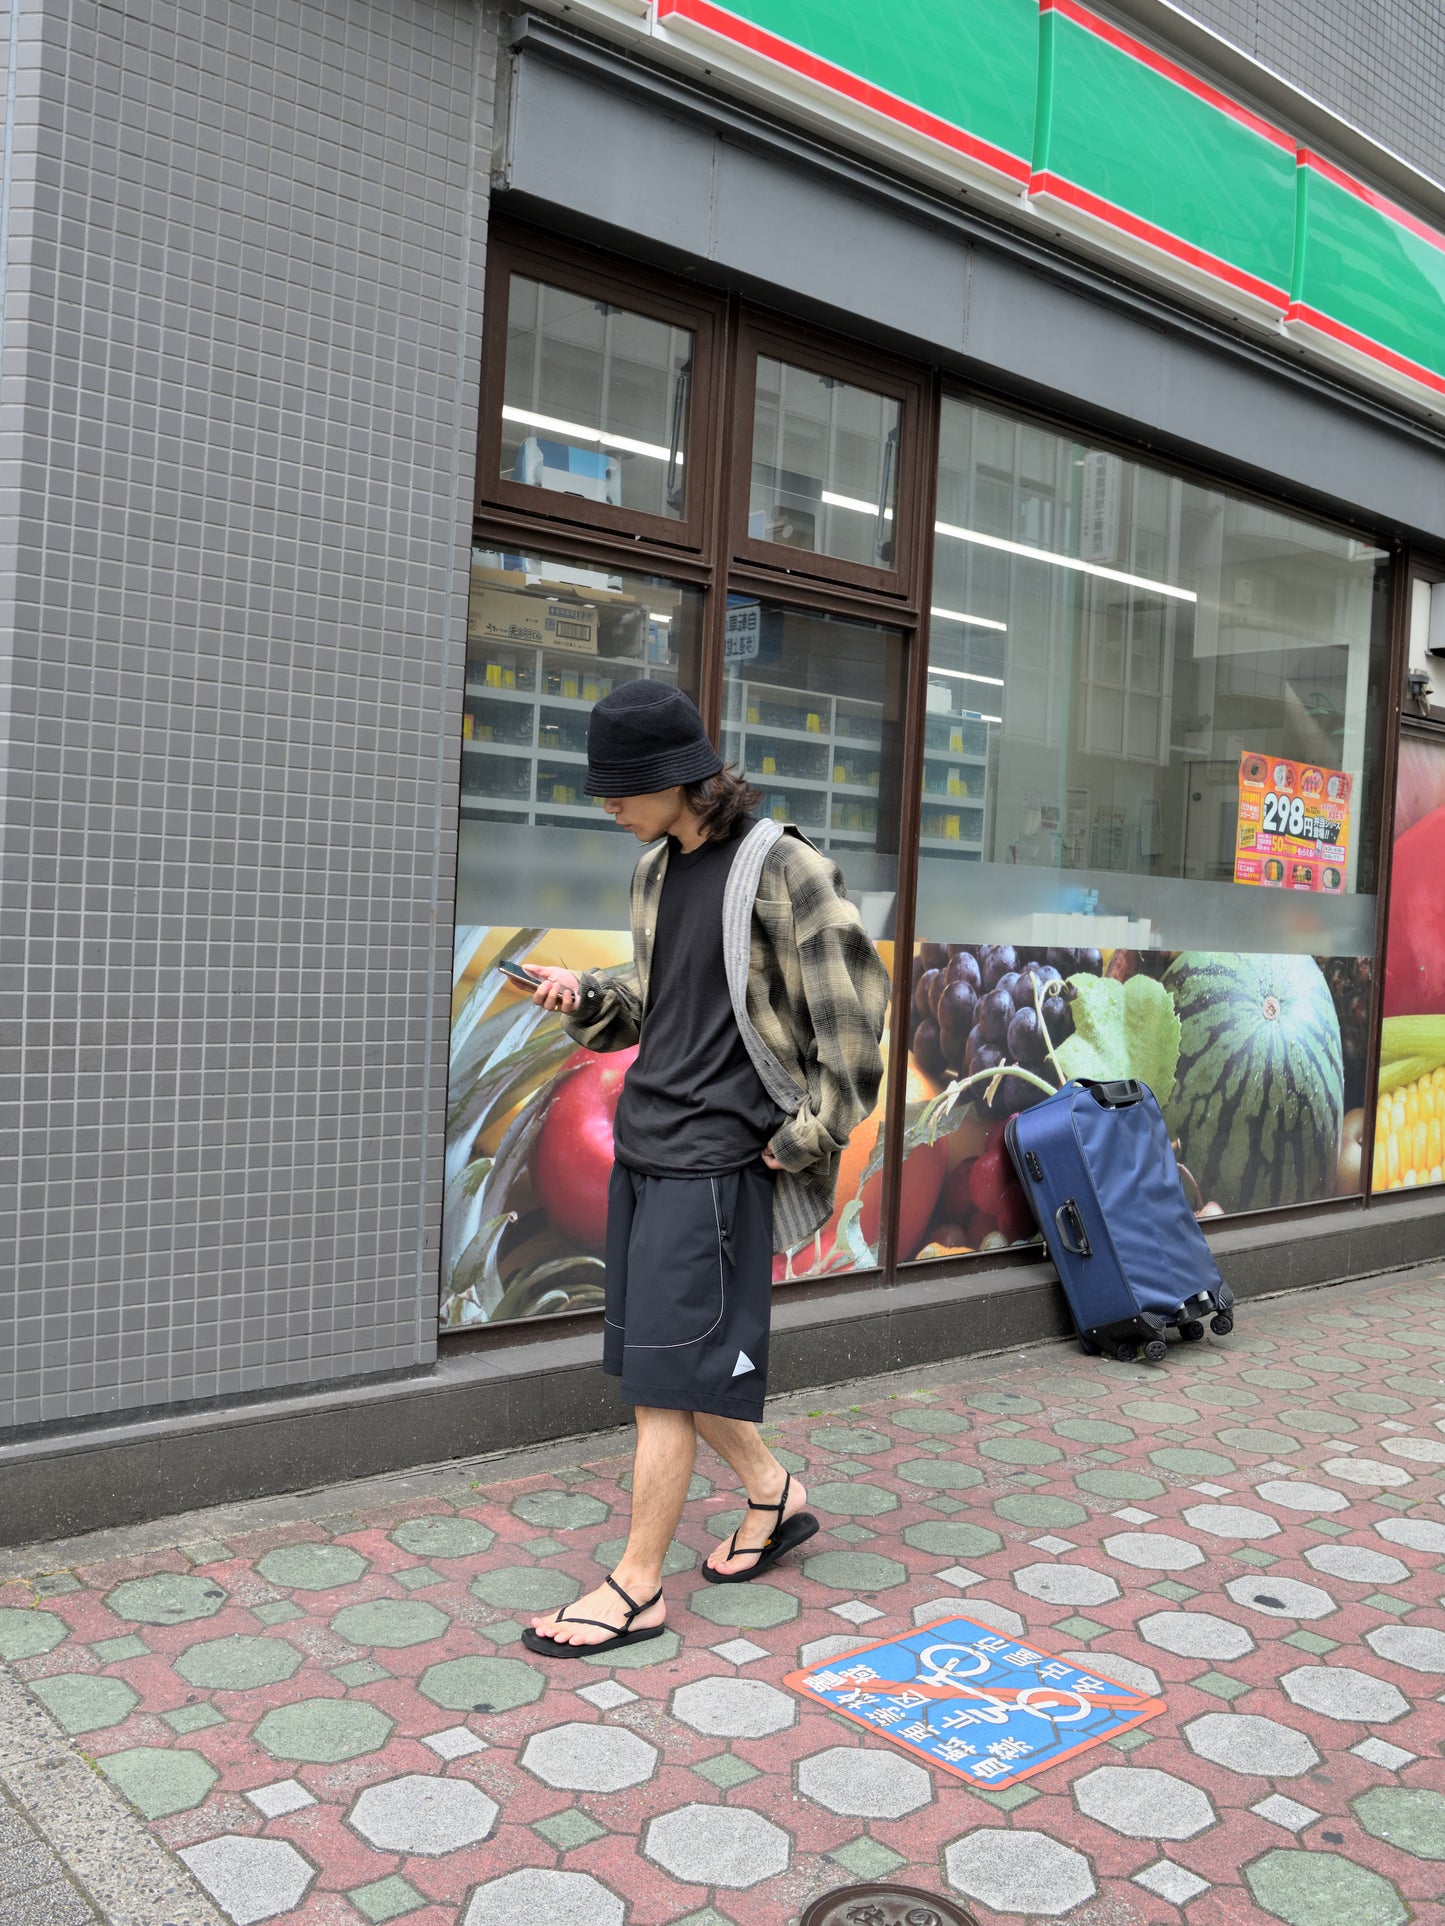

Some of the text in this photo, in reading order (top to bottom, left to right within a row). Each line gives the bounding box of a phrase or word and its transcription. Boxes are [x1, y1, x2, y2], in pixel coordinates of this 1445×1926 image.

[838, 1663, 1036, 1762] 禁止区域
[974, 1635, 1106, 1695] 名古屋市
[803, 1670, 1014, 1779] 自転車等放置
